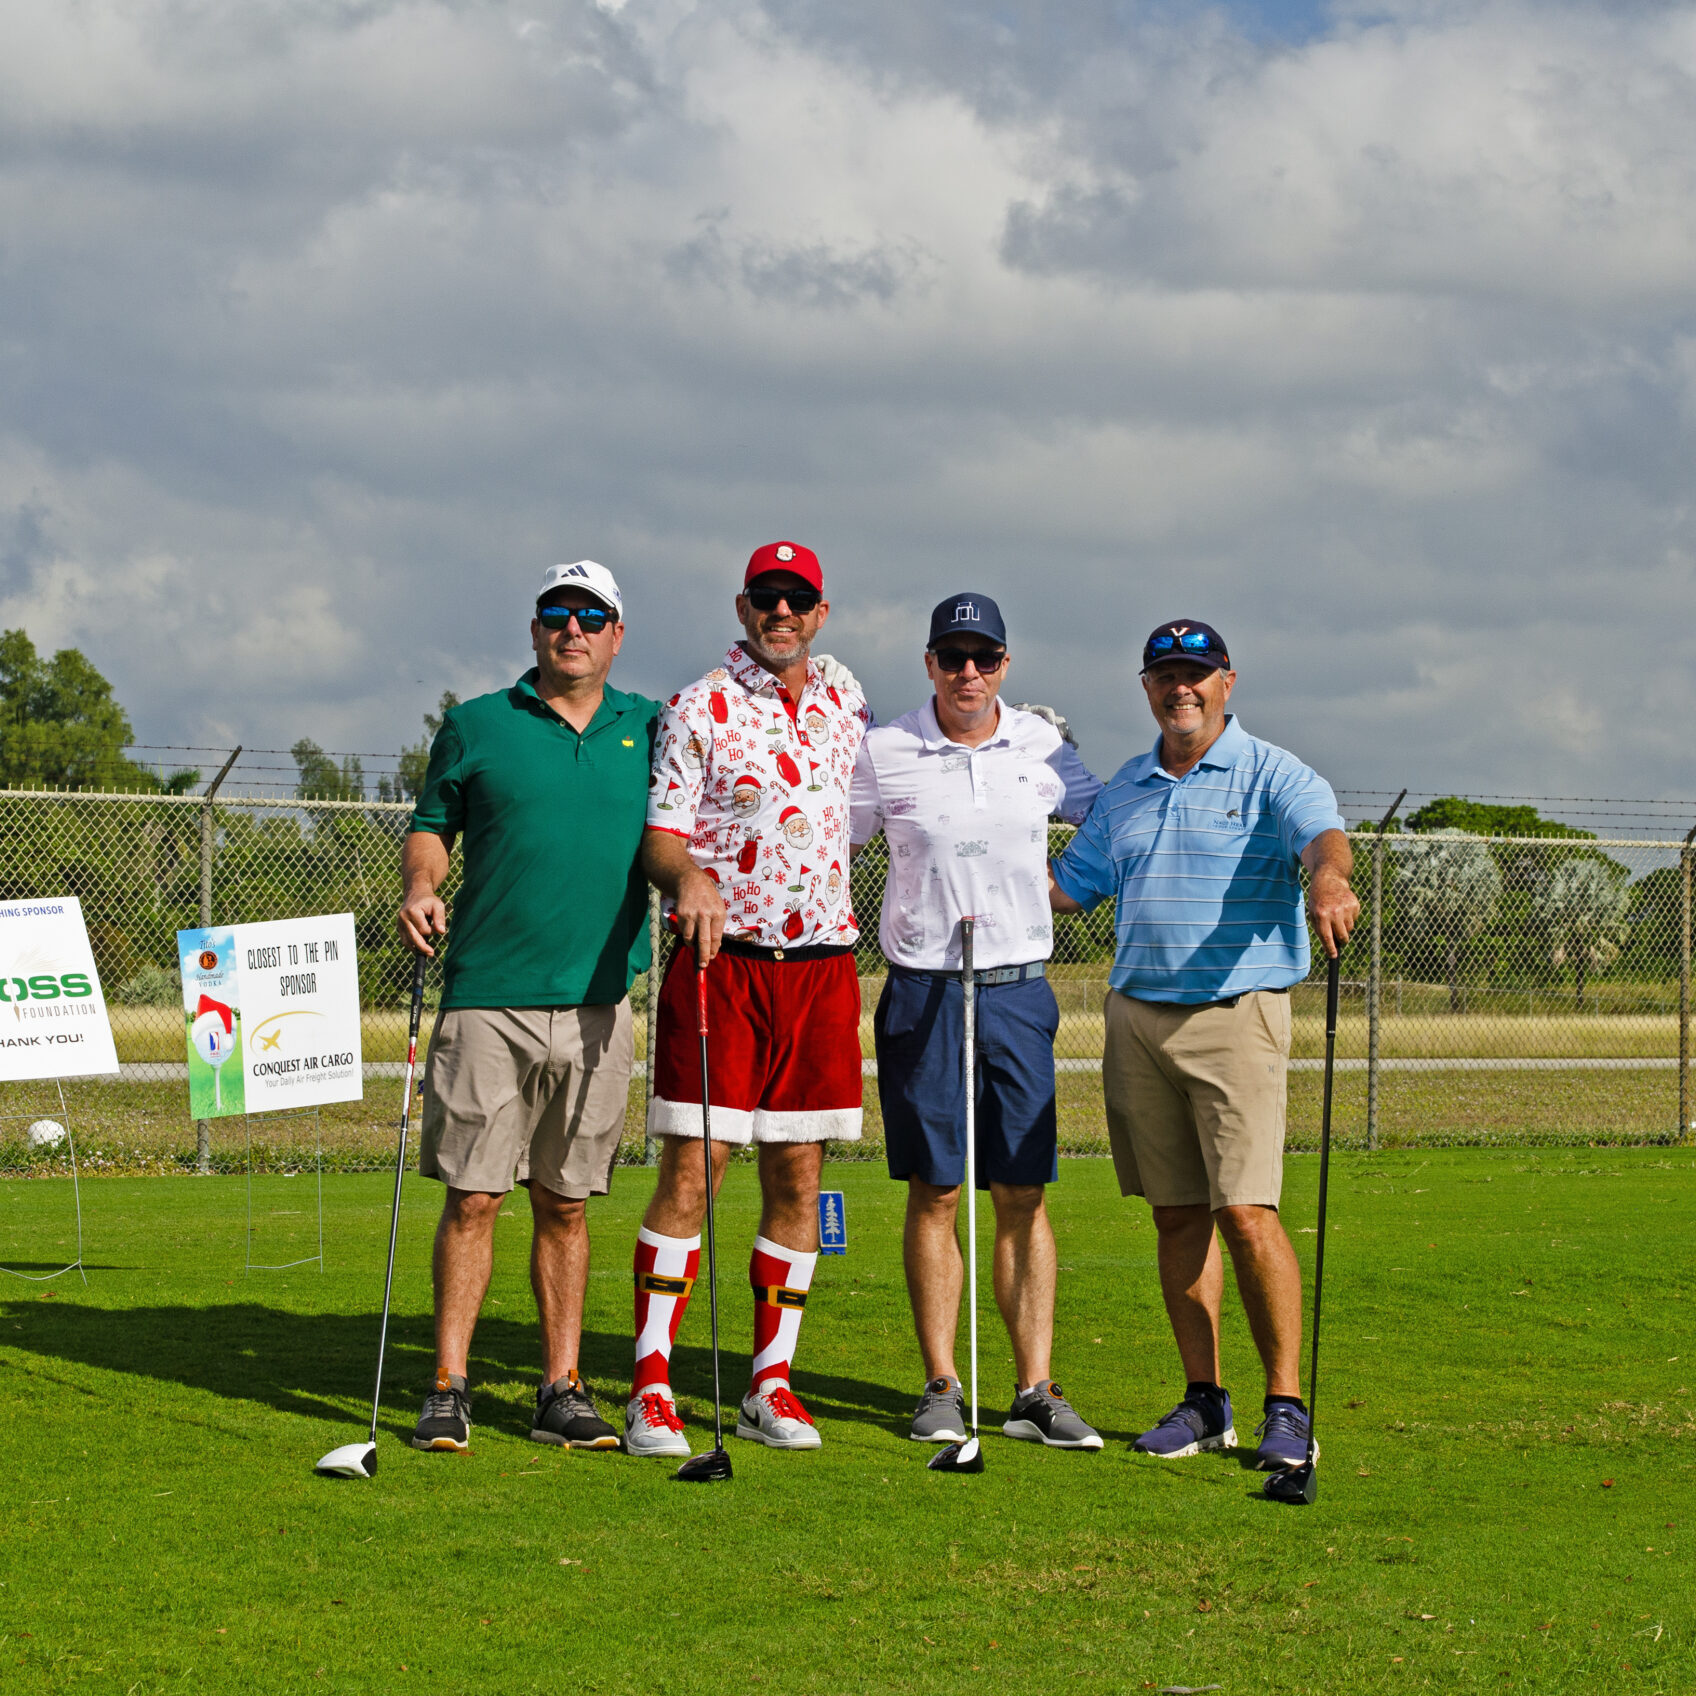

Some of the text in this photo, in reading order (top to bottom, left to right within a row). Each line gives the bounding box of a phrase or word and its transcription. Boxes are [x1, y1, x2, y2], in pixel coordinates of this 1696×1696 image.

[1169, 627, 1190, 637] V
[23, 905, 65, 917] SPONSOR
[247, 939, 339, 970] CLOSEST TO THE PIN
[0, 973, 93, 1002] OSS
[280, 972, 317, 997] SPONSOR
[22, 1003, 97, 1019] FOUNDATION
[45, 1033, 84, 1045] YOU!
[253, 1052, 354, 1077] CONQUEST AIR CARGO
[265, 1078, 279, 1088] Your
